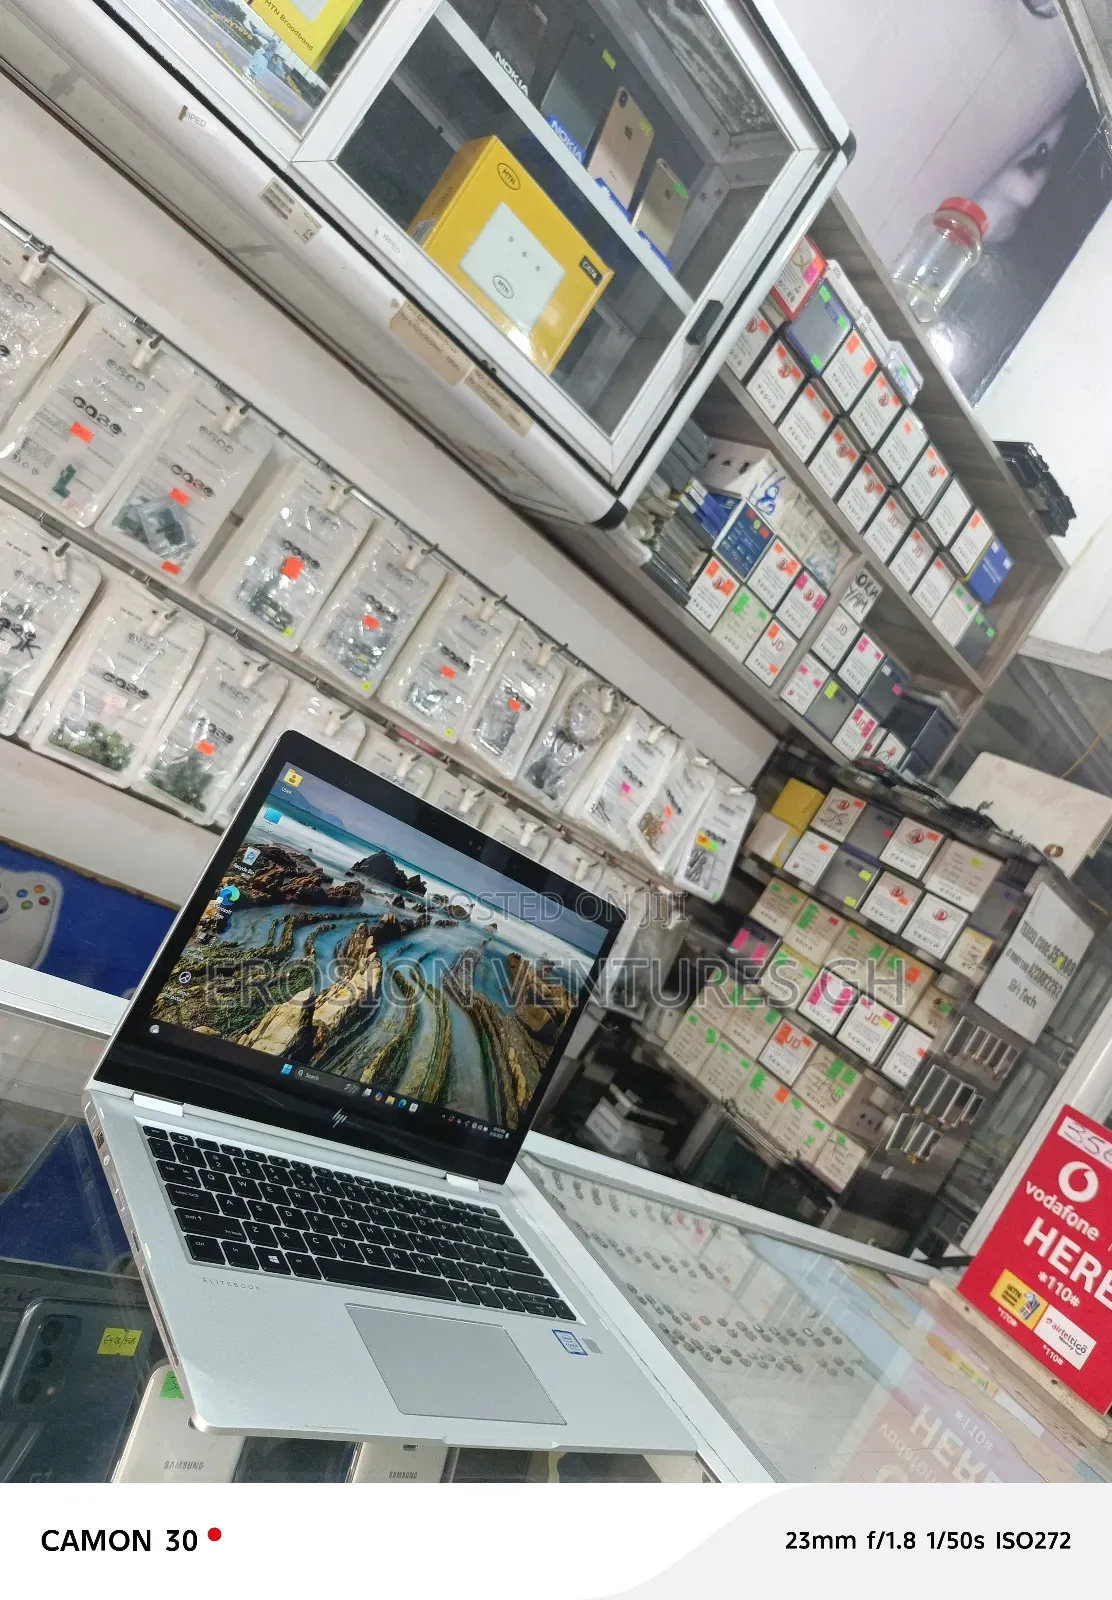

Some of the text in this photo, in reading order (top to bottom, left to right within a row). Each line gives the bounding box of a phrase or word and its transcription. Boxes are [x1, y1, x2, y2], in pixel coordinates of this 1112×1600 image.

[264, 0, 281, 17] MTN
[279, 14, 314, 51] Broadband
[494, 51, 529, 97] NOKIA
[549, 120, 584, 161] NOKIA
[502, 168, 517, 185] MTN
[72, 396, 123, 436] case
[171, 464, 214, 498] case
[102, 671, 150, 700] case
[865, 1012, 881, 1026] JD
[785, 1034, 800, 1049] JD
[1026, 1180, 1100, 1241] vodafone
[202, 1277, 261, 1291] ELITEBOOK
[1051, 1323, 1088, 1355] airteltigo
[163, 1460, 204, 1470] SAMSUNG
[388, 1470, 418, 1480] SAMSUNG
